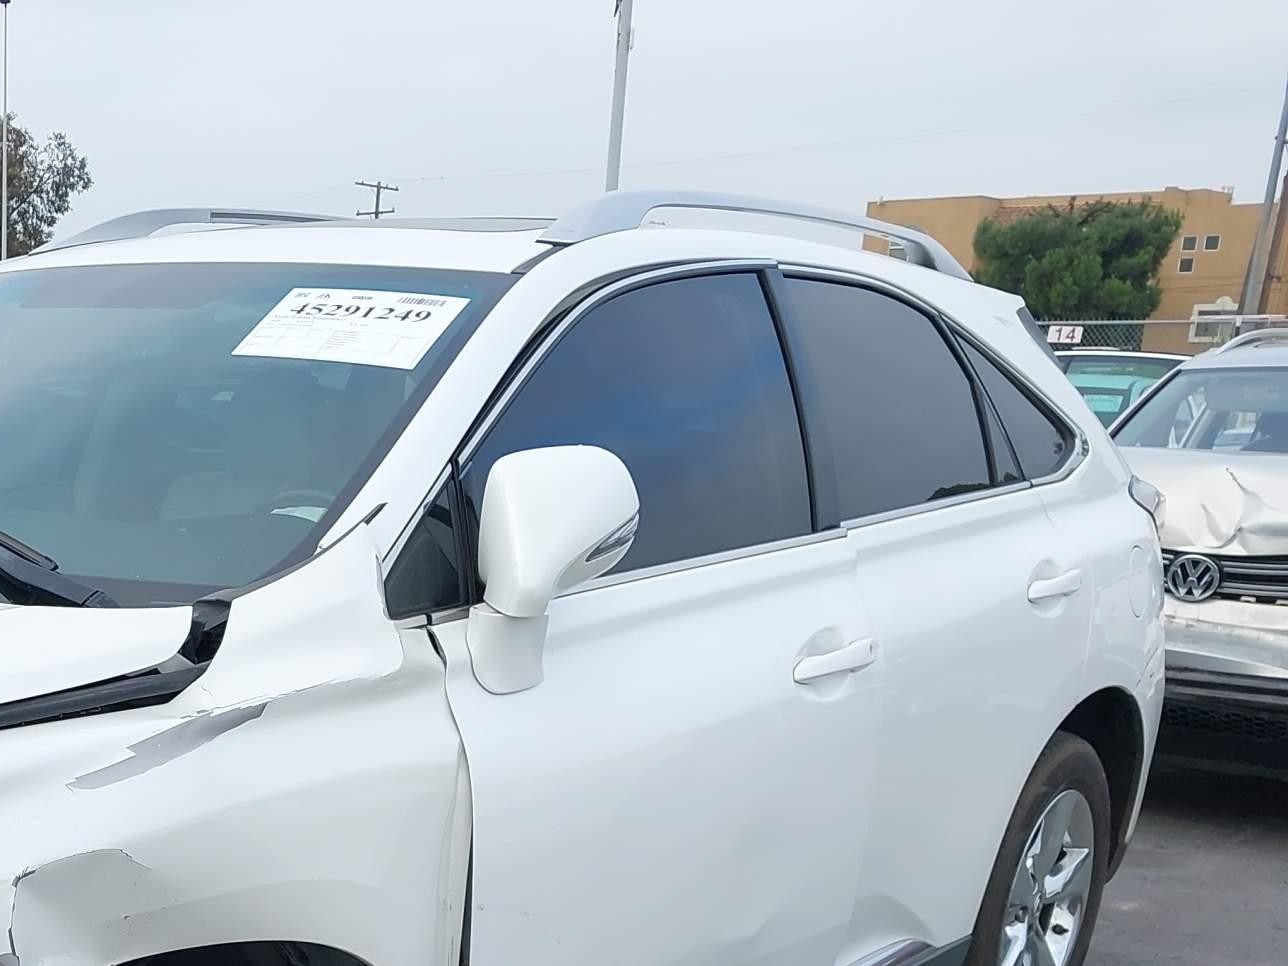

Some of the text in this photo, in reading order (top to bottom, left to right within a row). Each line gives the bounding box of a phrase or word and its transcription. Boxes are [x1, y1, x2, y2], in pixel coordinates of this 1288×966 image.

[290, 303, 432, 323] 45291249
[1055, 327, 1076, 342] 14
[1169, 555, 1218, 600] VW
